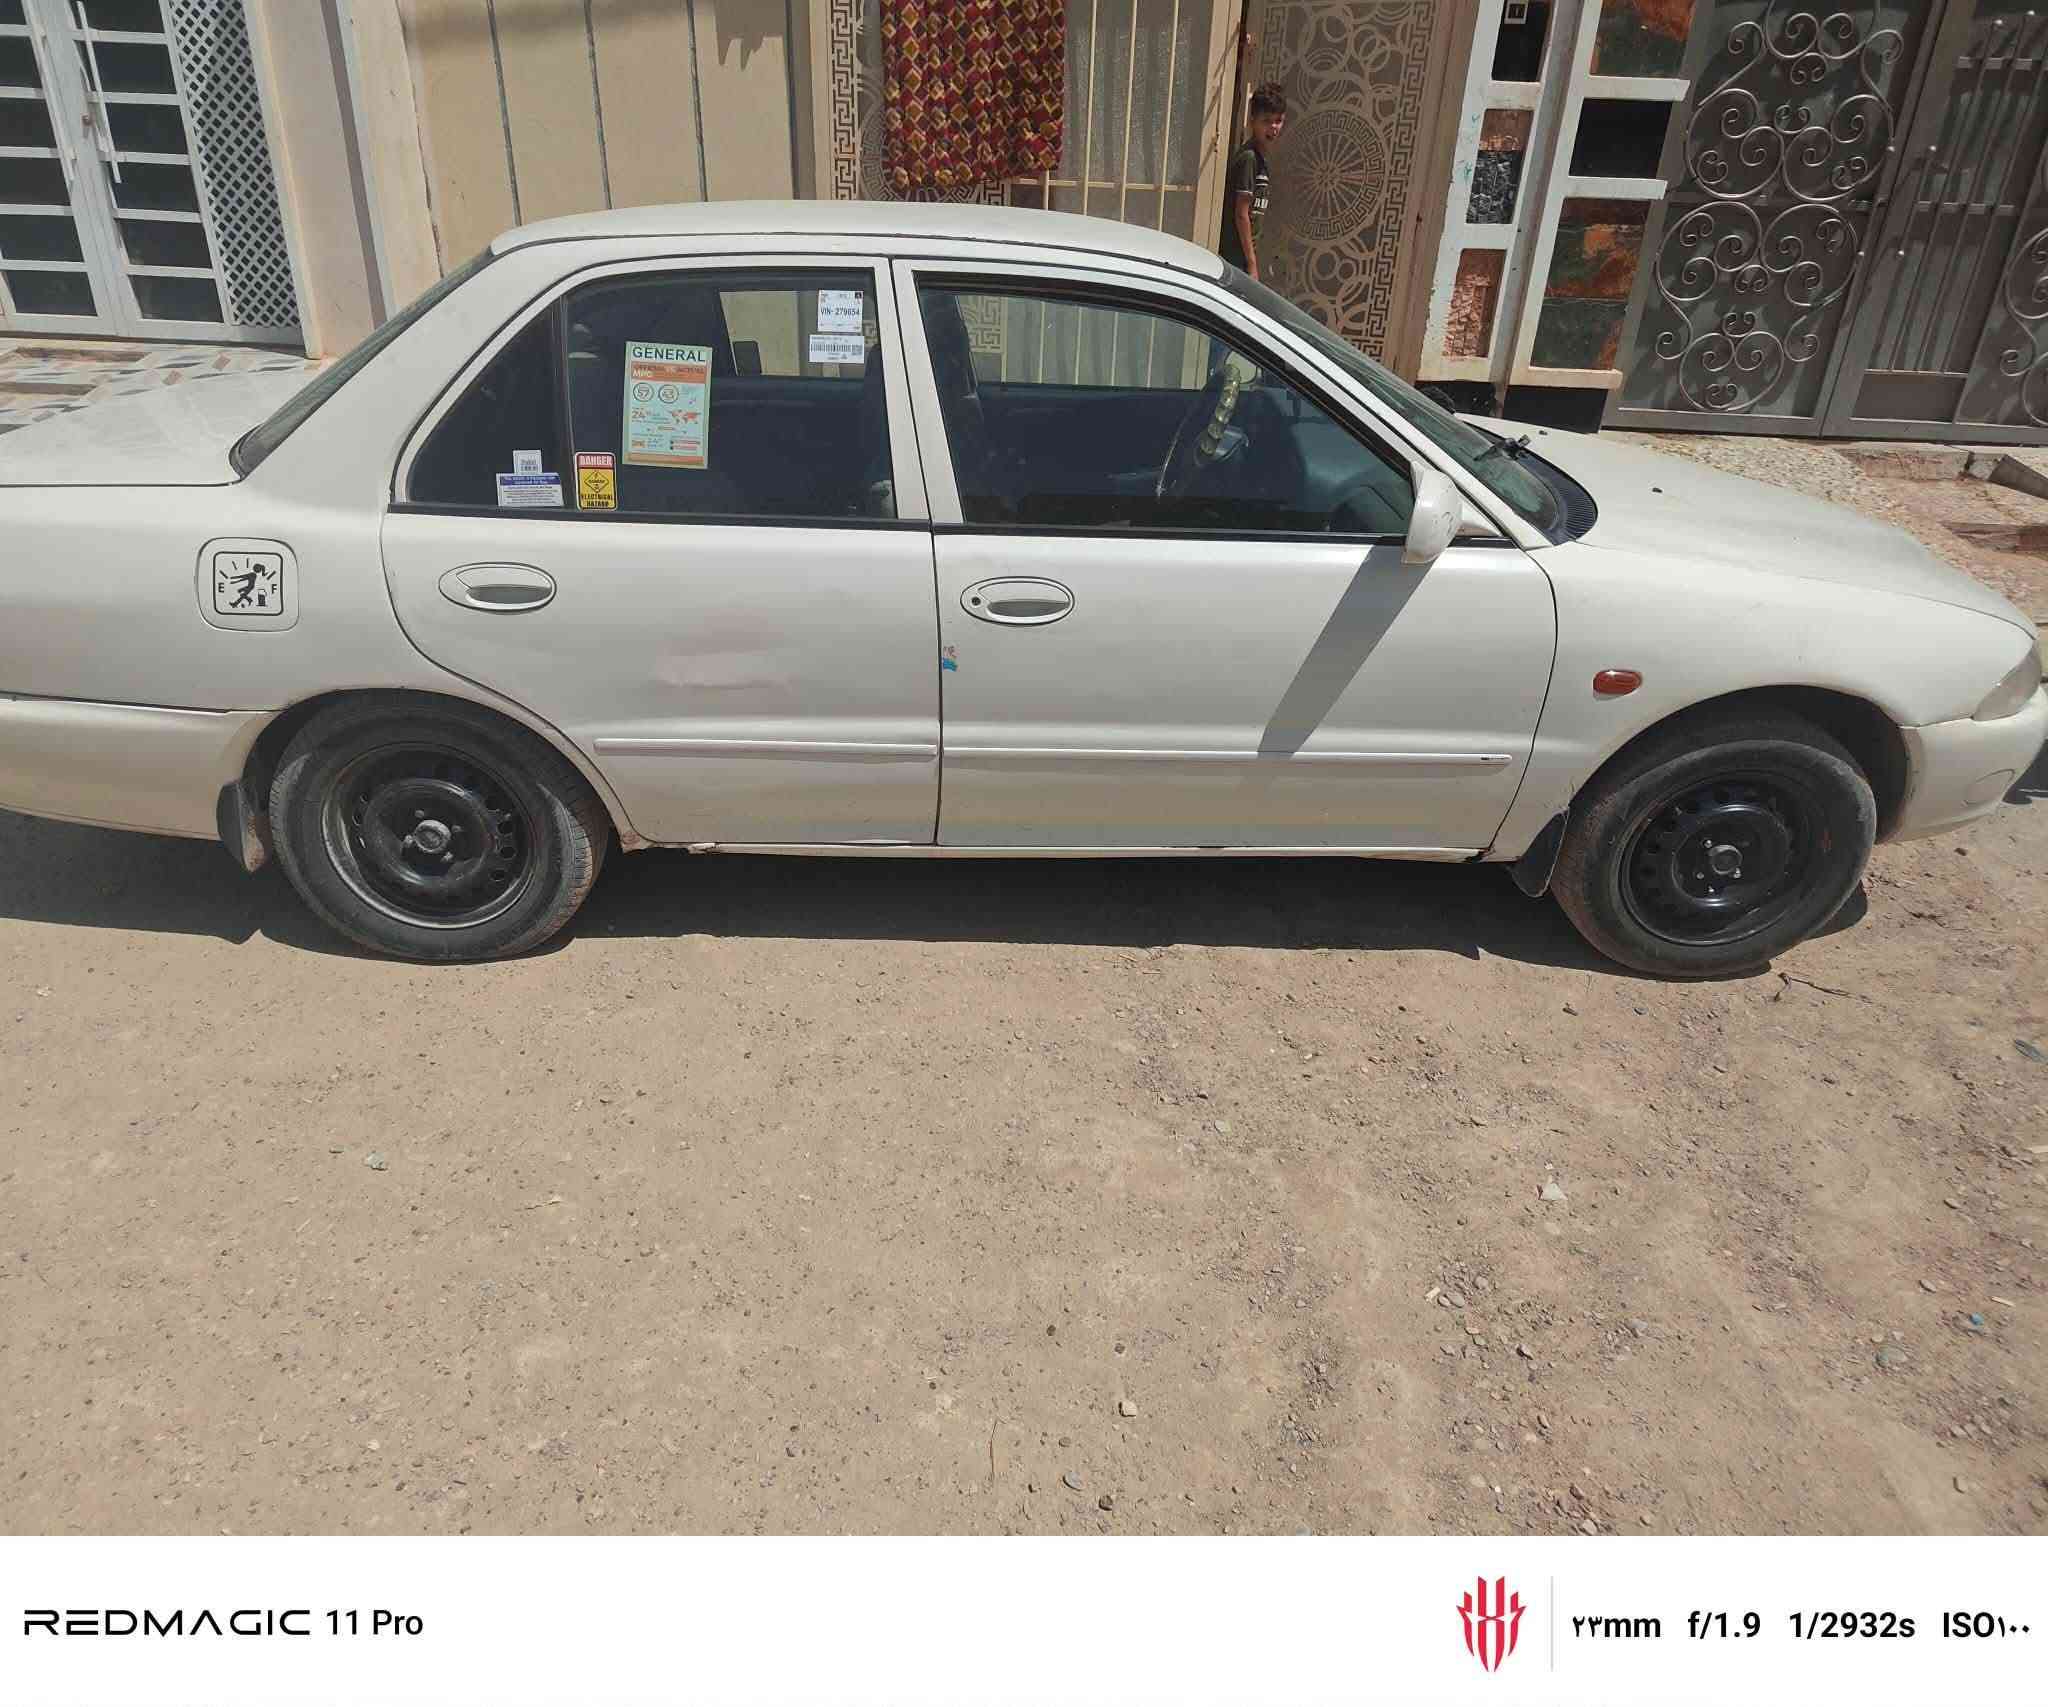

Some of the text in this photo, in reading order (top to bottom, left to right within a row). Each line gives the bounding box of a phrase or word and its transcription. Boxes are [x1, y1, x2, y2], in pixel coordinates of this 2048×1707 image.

[632, 346, 706, 362] GENERAL
[579, 455, 613, 465] DANGER
[218, 582, 225, 593] E
[271, 583, 278, 594] F
